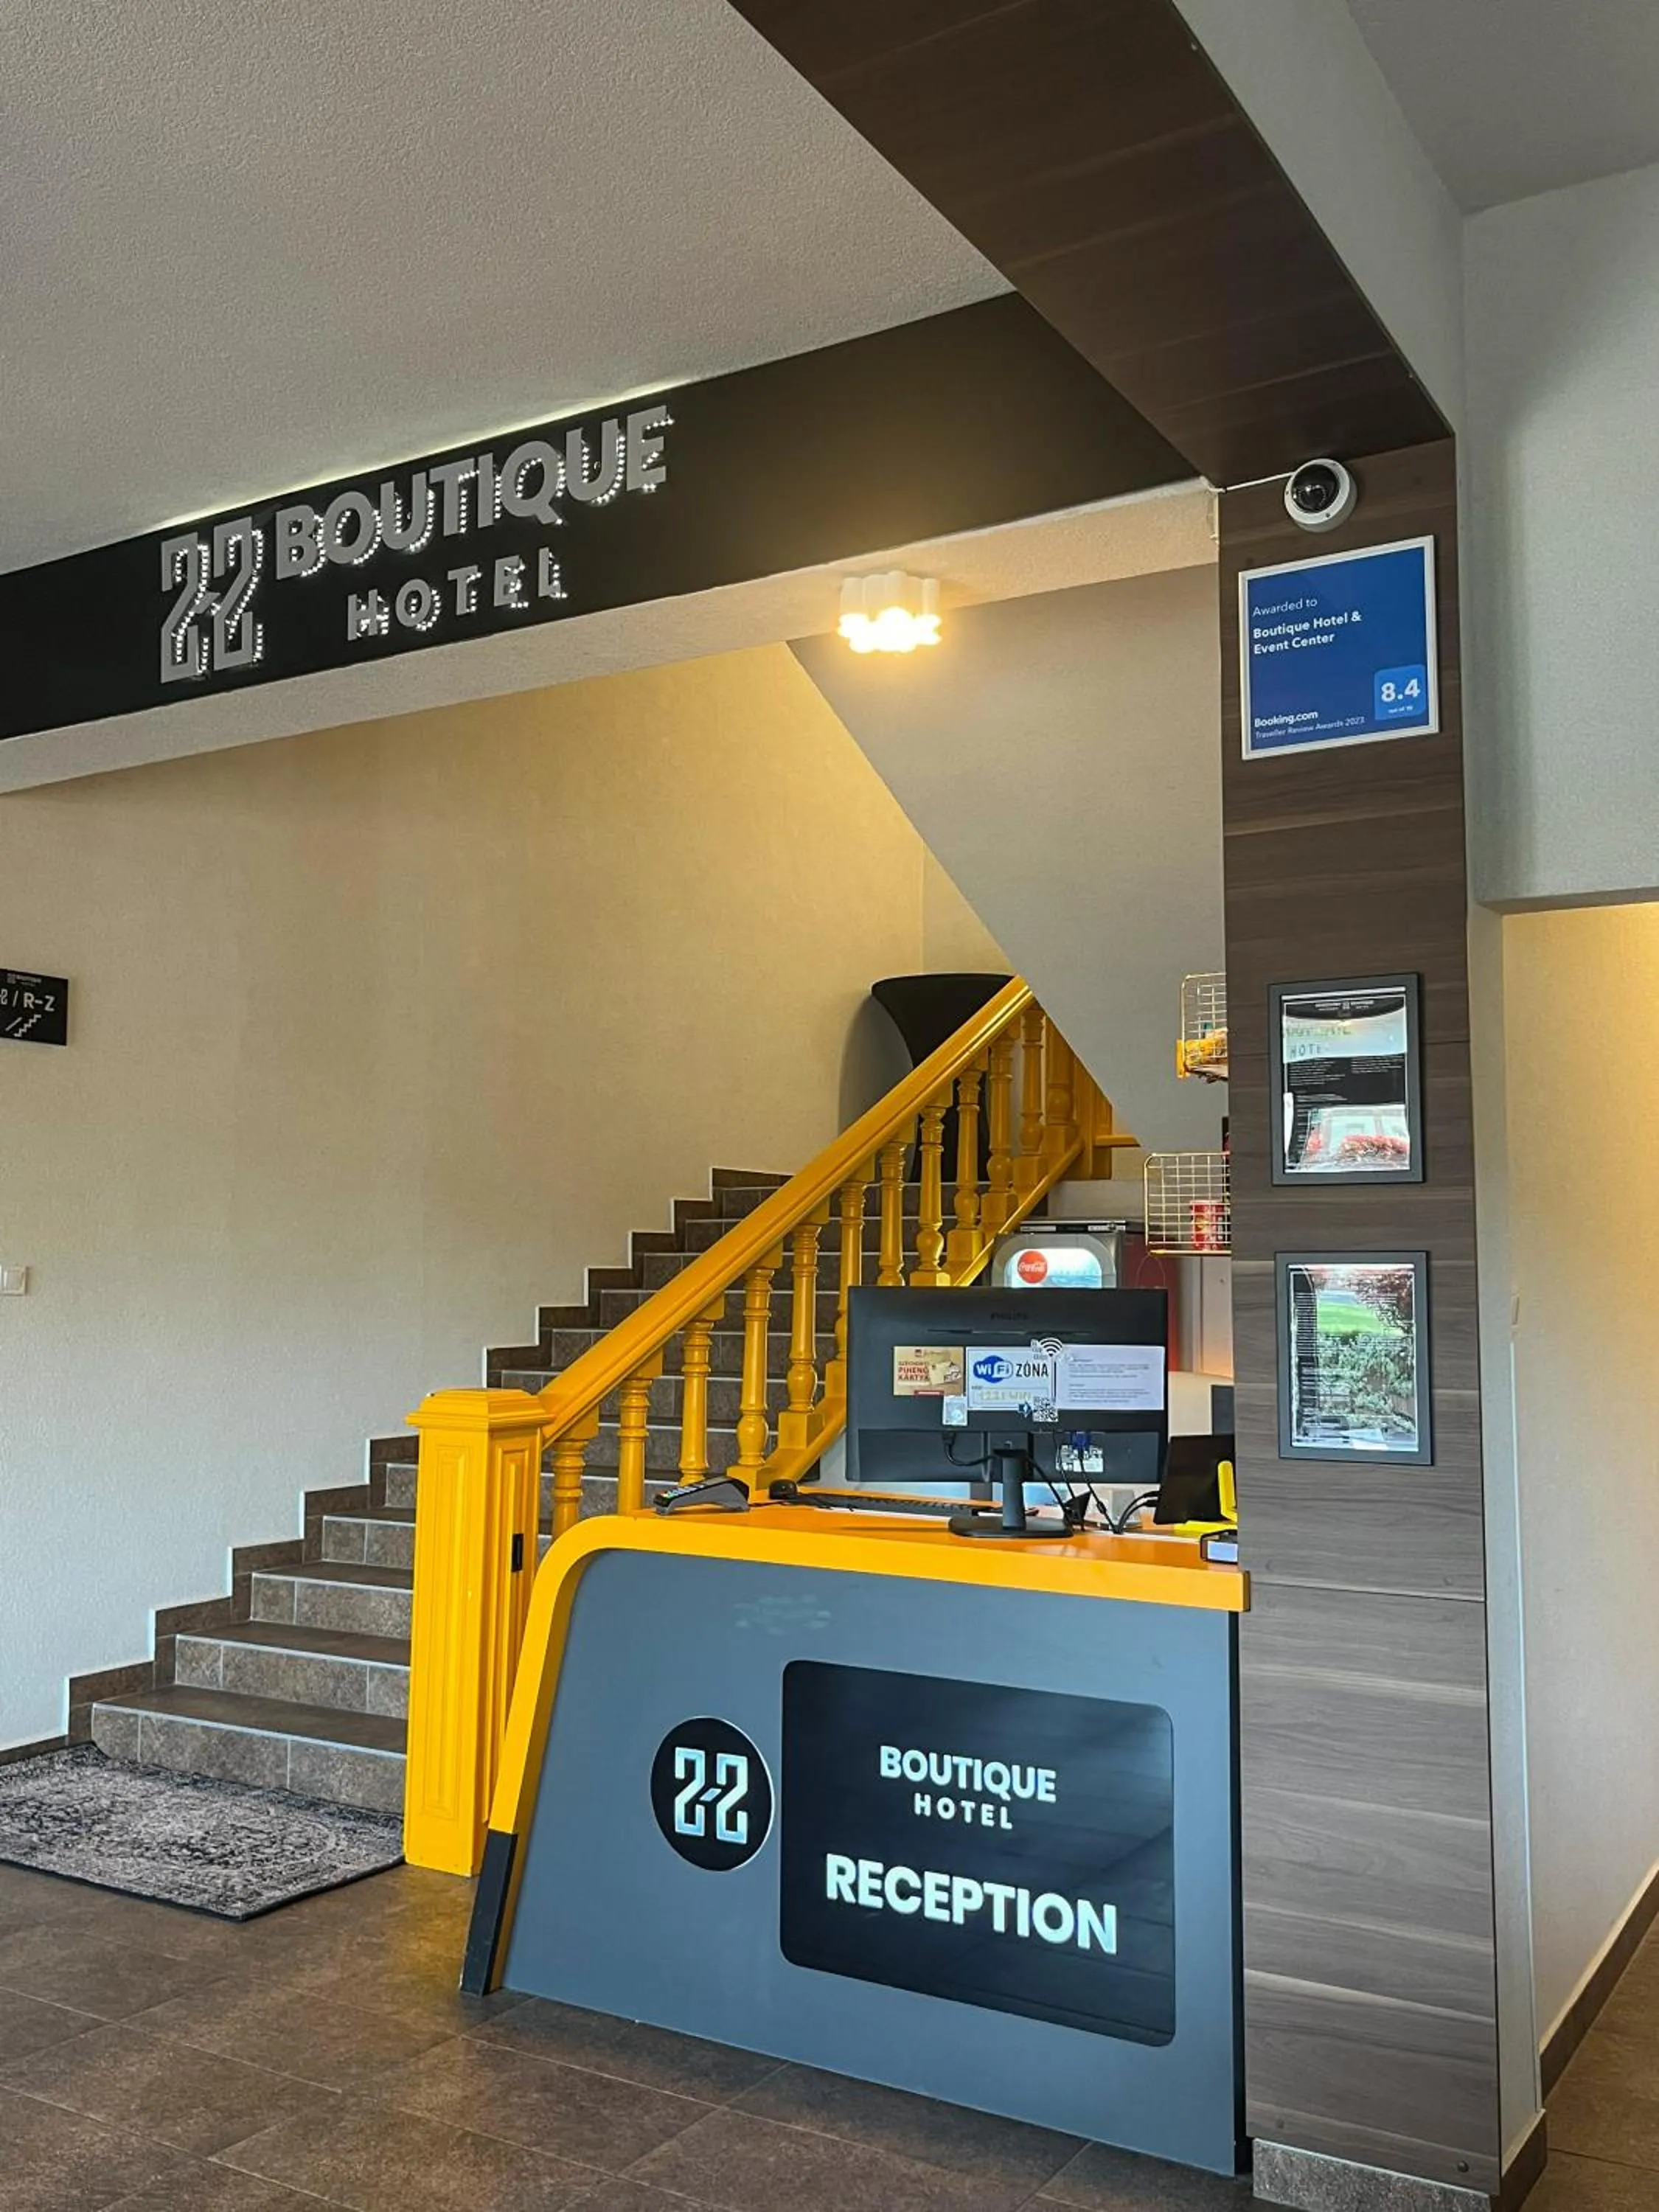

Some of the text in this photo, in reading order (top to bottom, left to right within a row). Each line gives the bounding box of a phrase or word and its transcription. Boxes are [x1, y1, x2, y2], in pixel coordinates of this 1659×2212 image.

[276, 406, 674, 580] BOUTIQUE
[347, 546, 568, 640] HOTEL
[1253, 598, 1318, 616] Awarded to
[1253, 611, 1363, 639] Boutique Hotel &
[1254, 633, 1335, 655] Event Center
[1380, 678, 1421, 702] 8.4
[1254, 712, 1318, 728] Booking.com
[1315, 720, 1343, 729] Awards
[24, 992, 55, 1012] R-Z
[1016, 1360, 1048, 1377] ZÓNA
[880, 1745, 1057, 1804] BOUTIQUE
[914, 1792, 1012, 1829] HOTEL
[826, 1853, 1118, 1955] RECEPTION
